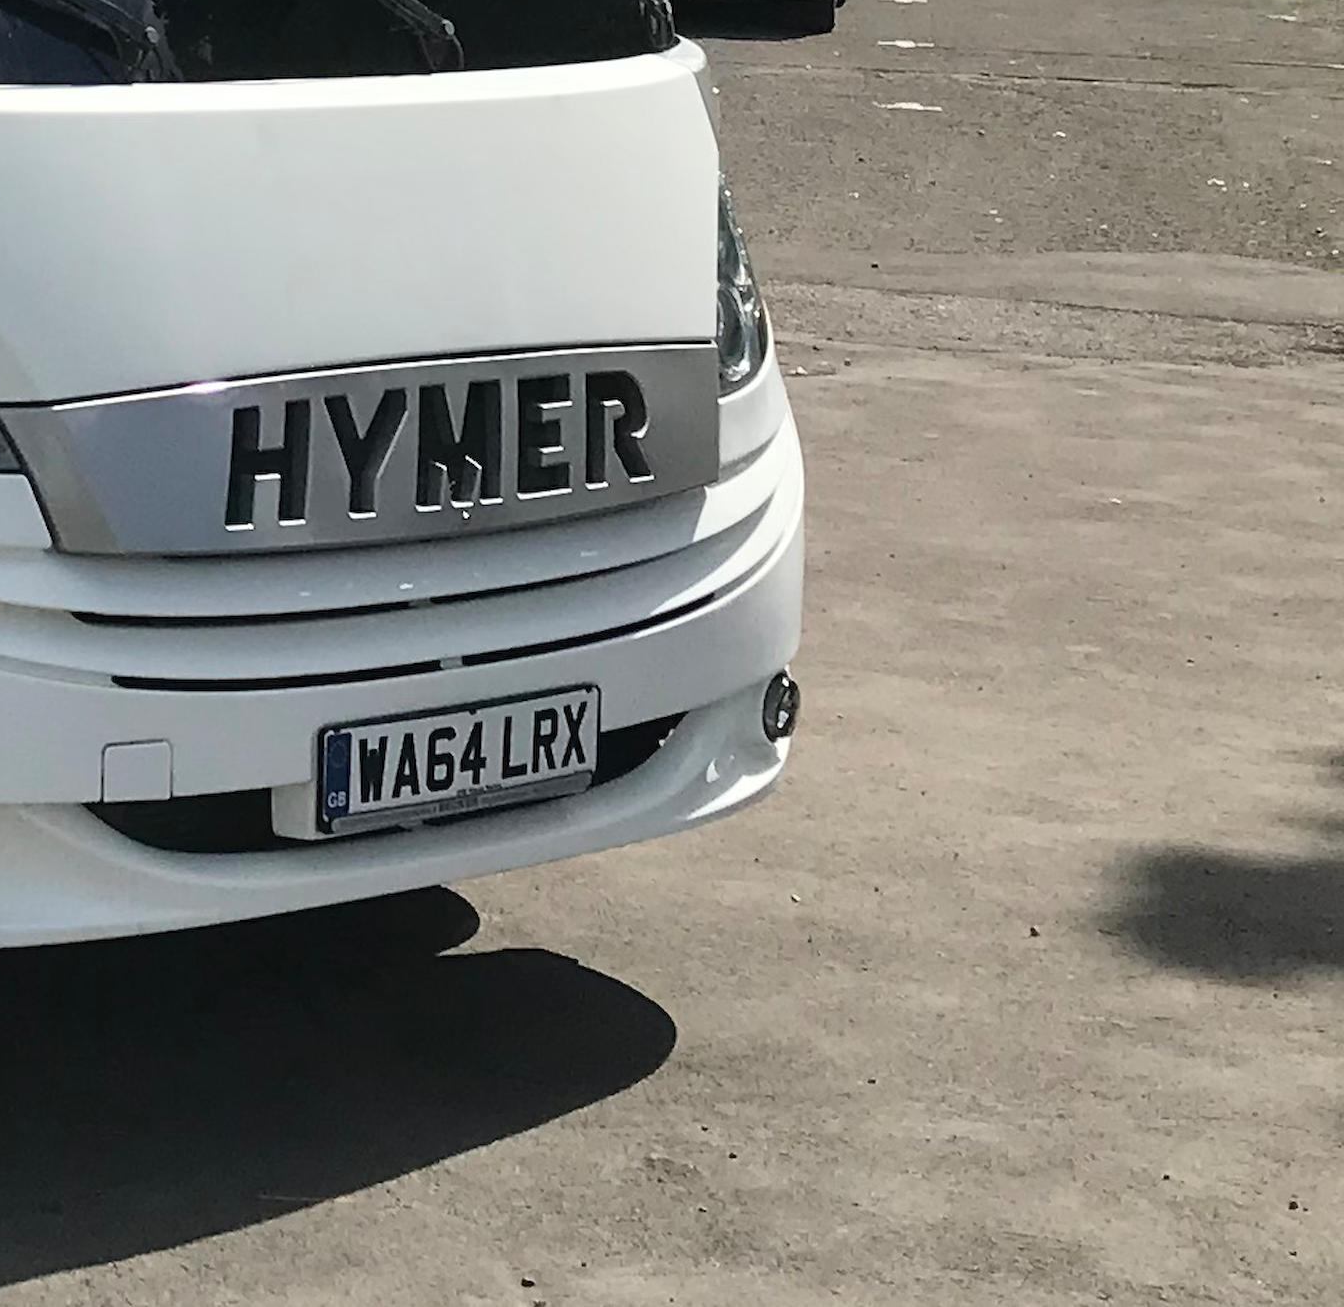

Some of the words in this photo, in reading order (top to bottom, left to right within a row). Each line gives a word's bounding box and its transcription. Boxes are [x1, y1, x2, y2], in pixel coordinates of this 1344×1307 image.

[224, 370, 656, 531] HYMER
[327, 791, 347, 809] GB
[358, 720, 487, 804] WA64
[501, 701, 588, 780] LRX
